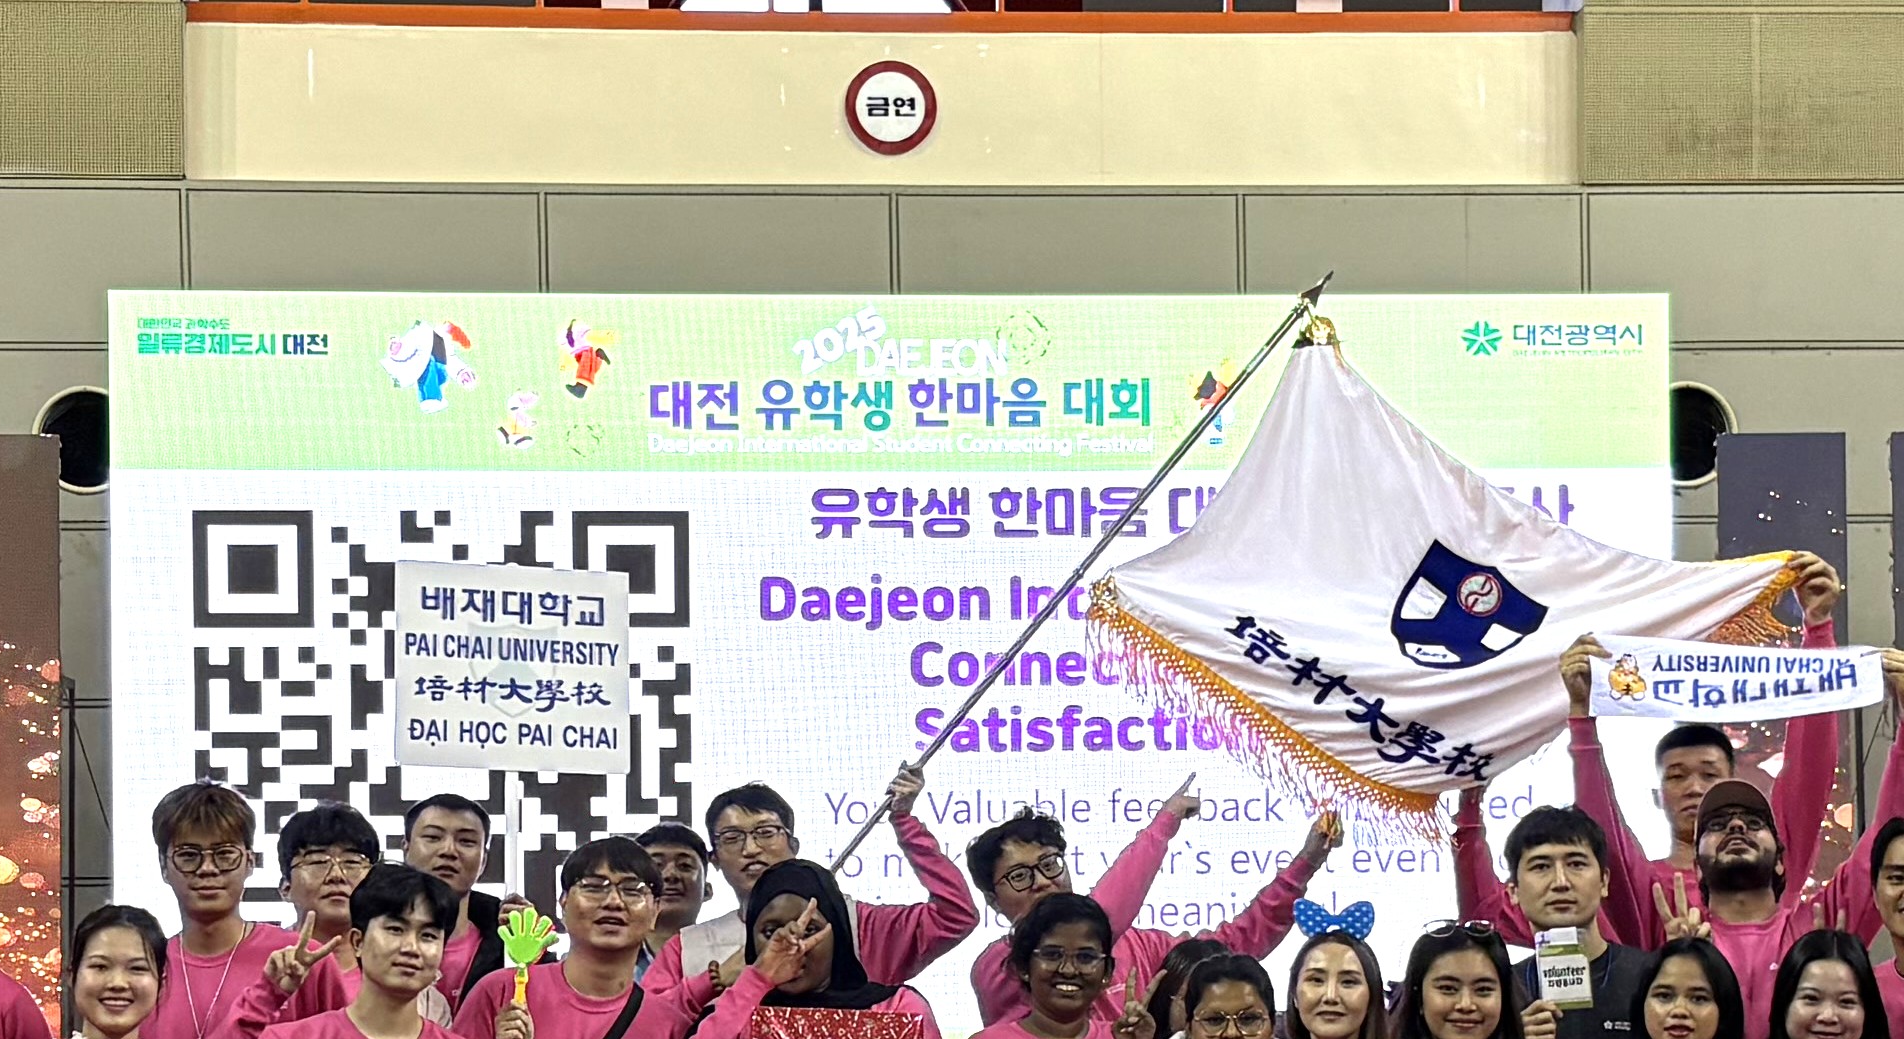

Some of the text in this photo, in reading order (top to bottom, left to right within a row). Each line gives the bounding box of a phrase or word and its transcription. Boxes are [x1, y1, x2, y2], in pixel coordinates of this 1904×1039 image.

[865, 96, 916, 117] 금연
[137, 333, 329, 355] 일류경제도시 대전
[793, 306, 1009, 377] 2025 DAEJEON
[1512, 324, 1643, 346] 대전광역시
[649, 377, 1152, 432] 대전 유학생 한마음 대회
[647, 432, 1154, 456] Daejeon International Student Connecting Festival
[810, 486, 971, 539] 유학생
[988, 486, 1148, 539] 한마음
[421, 586, 605, 627] 배재대학교
[760, 573, 991, 631] Daejeon
[405, 632, 620, 667] PAI CHAI UNIVERSITY
[910, 641, 1122, 687] Connec
[1652, 654, 1770, 674] UNIVERSITY
[1776, 657, 1824, 674] CHAI
[414, 675, 612, 712] 培材大學校
[408, 718, 618, 750] ĐẠI HỌC PAI CHAI
[914, 705, 1222, 753] Satisfactio
[1108, 788, 1284, 823] feeback
[1352, 849, 1441, 874] even
